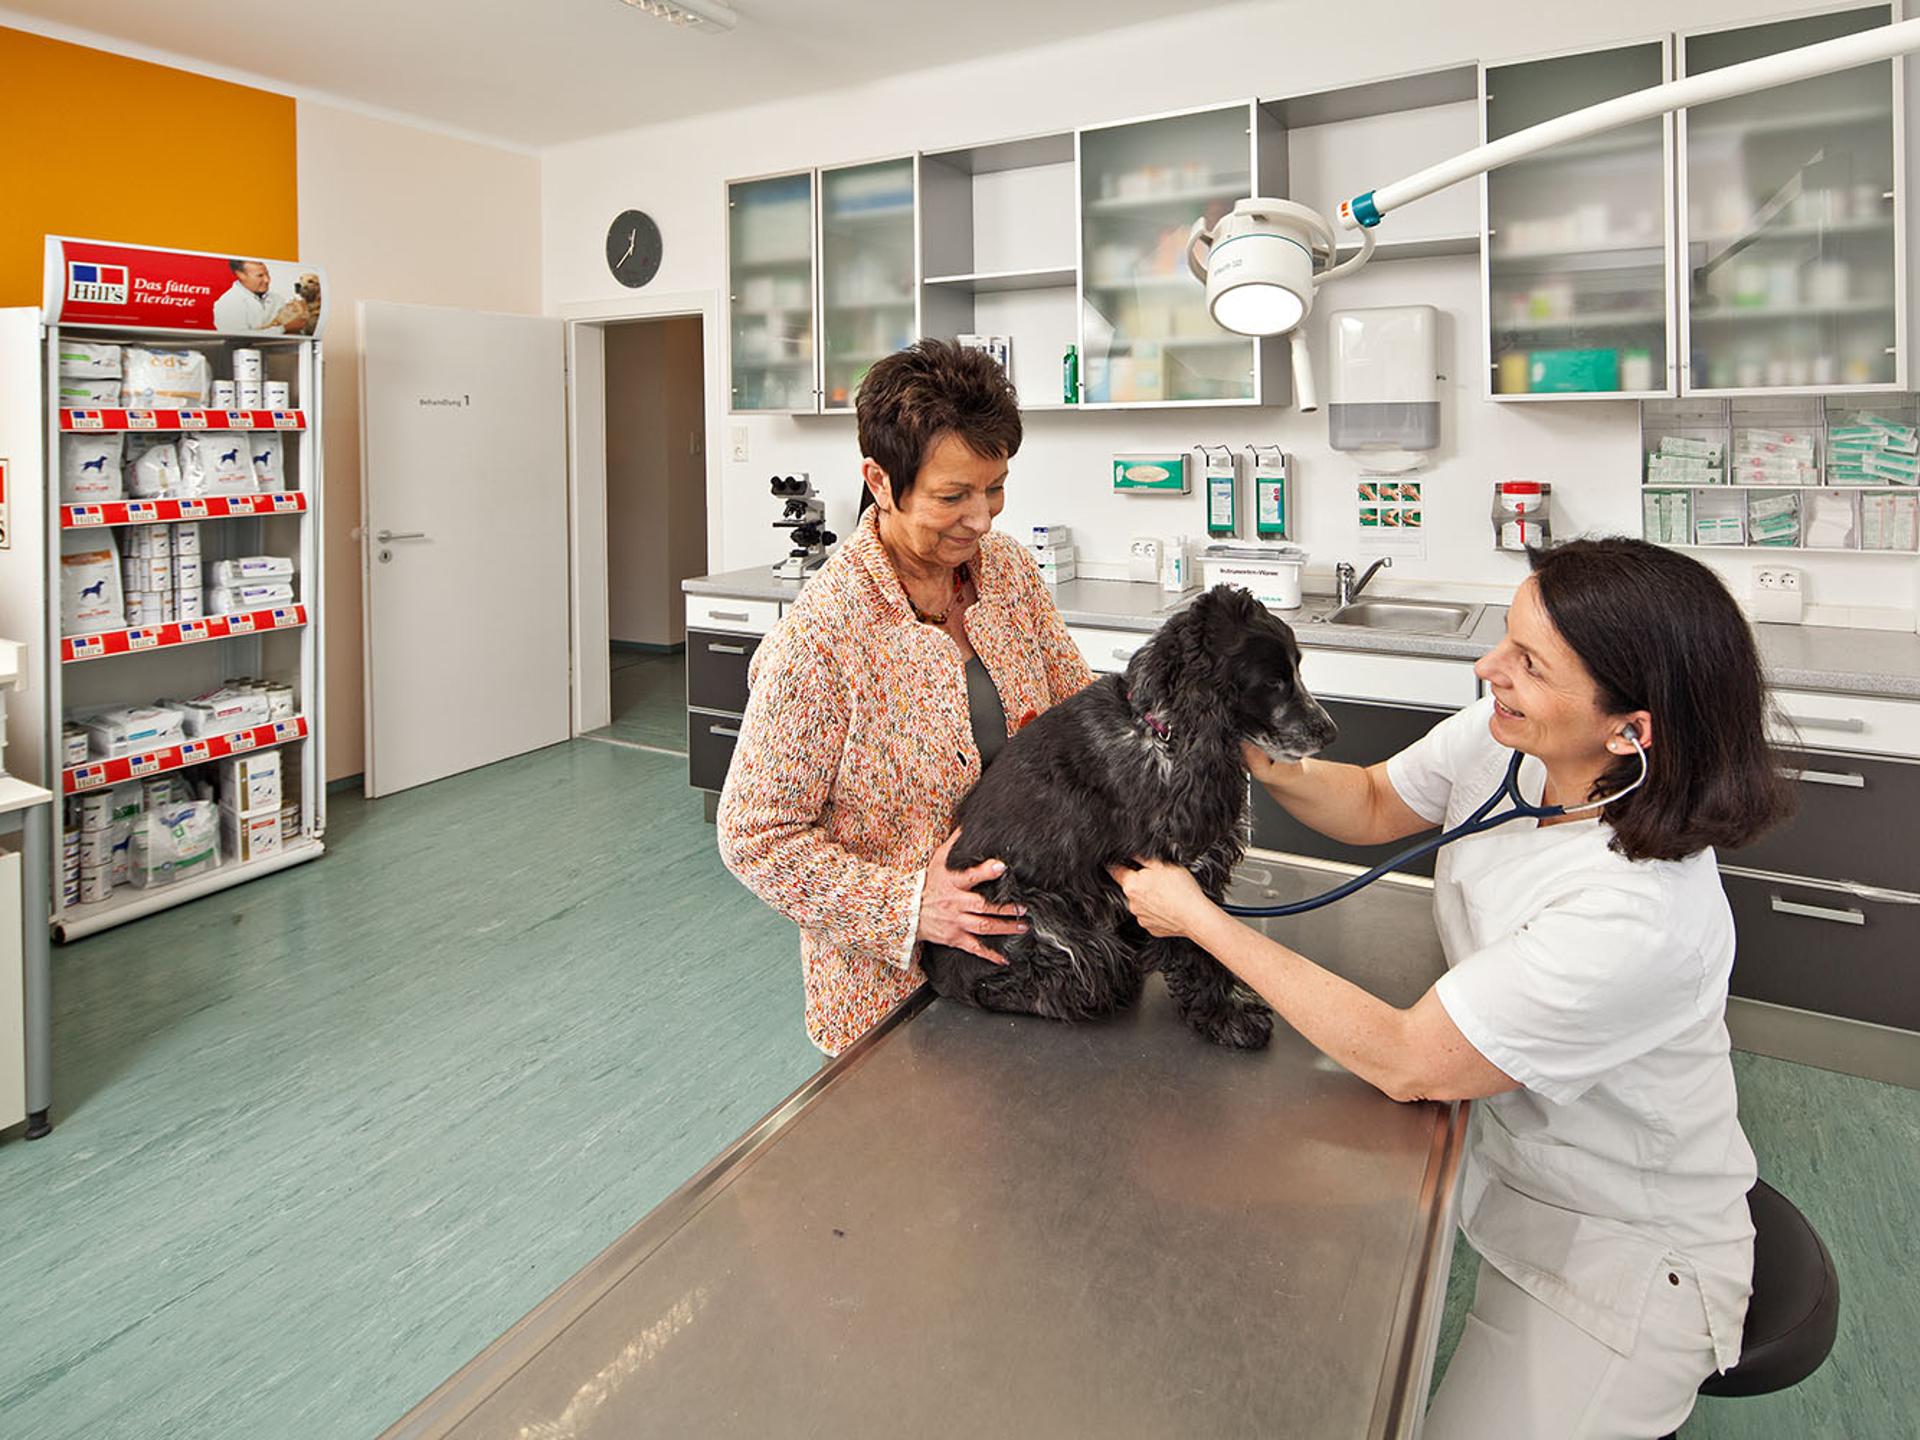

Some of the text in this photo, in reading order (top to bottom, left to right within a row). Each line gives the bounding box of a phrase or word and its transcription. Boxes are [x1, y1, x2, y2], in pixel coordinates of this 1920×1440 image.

[74, 284, 124, 302] Hill's
[134, 278, 211, 295] Das füttern
[134, 292, 197, 307] Tierärzte
[419, 395, 470, 407] Behandlung 1
